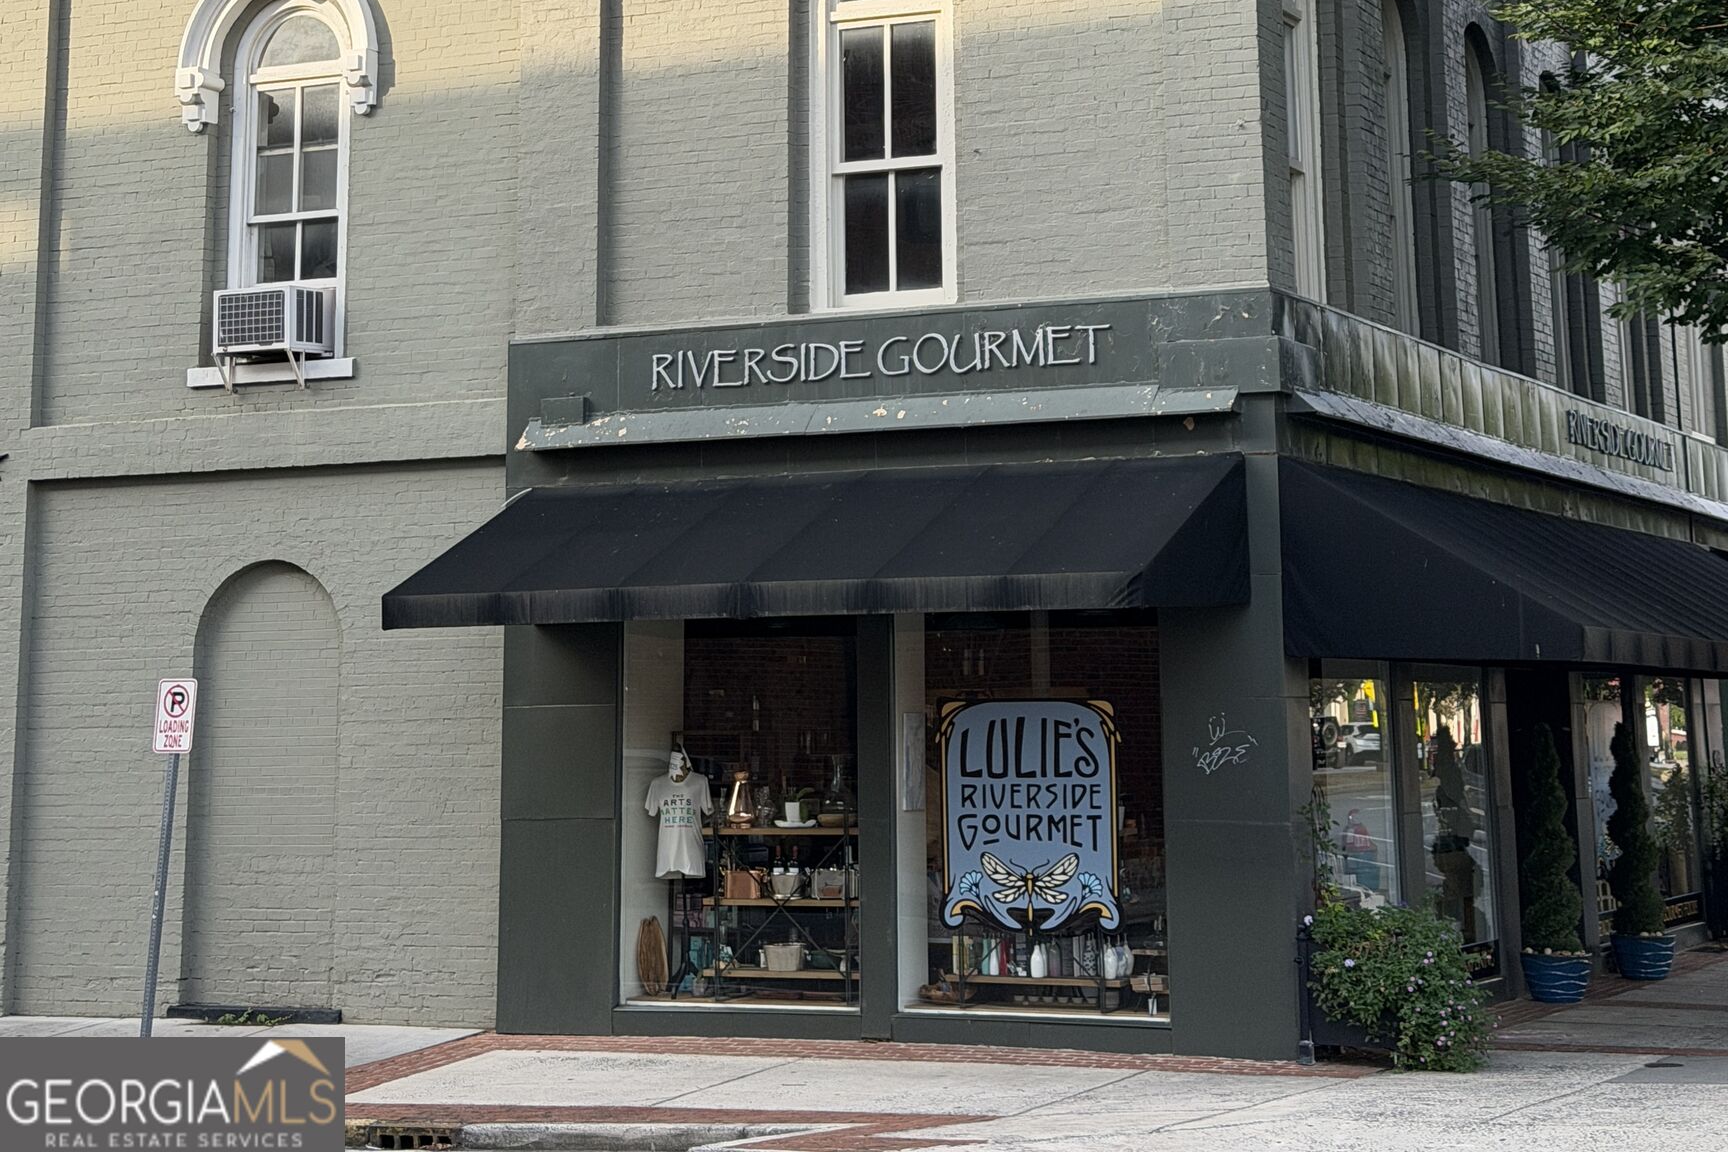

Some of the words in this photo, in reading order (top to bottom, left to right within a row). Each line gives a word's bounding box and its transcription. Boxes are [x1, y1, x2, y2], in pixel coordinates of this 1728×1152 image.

[651, 339, 872, 391] RIVERSIDE
[877, 323, 1111, 376] GOURMET
[1566, 408, 1629, 459] RIVERSIDE
[159, 719, 190, 734] LOADING
[163, 734, 183, 748] ZONE
[960, 716, 1100, 779] LULIE'S
[663, 798, 692, 807] ARTS
[960, 783, 1103, 810] RIVERSIDE
[664, 816, 694, 824] HERE
[957, 813, 1103, 852] GOURMET
